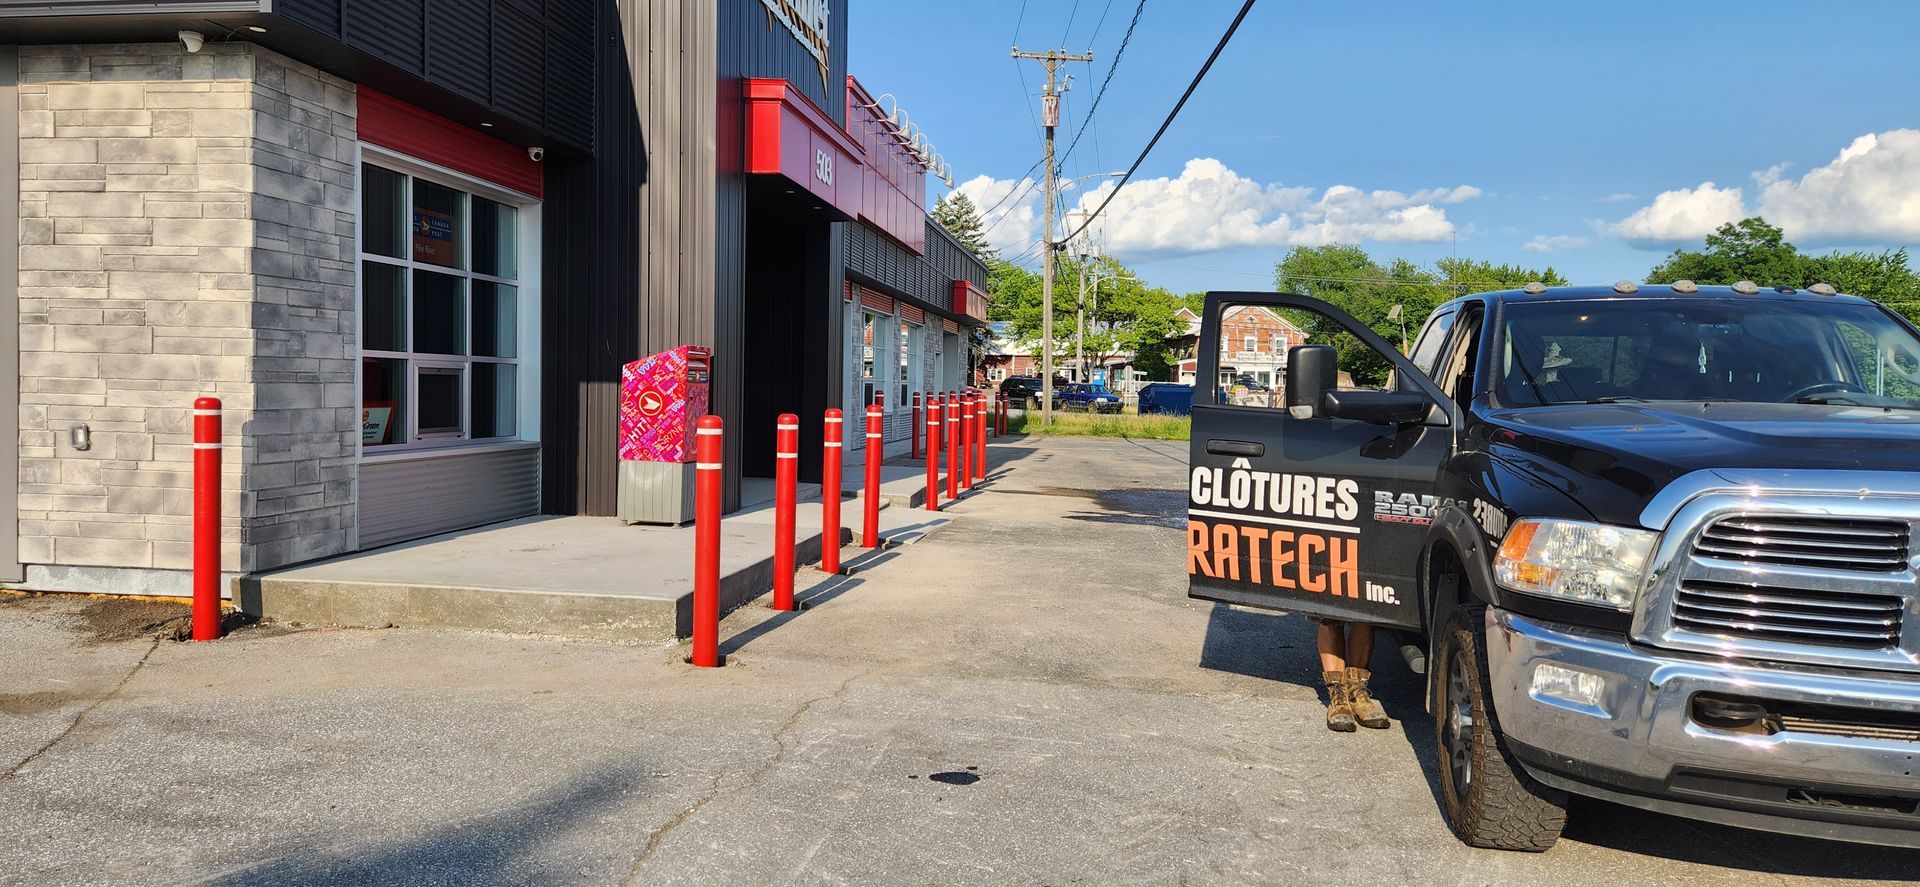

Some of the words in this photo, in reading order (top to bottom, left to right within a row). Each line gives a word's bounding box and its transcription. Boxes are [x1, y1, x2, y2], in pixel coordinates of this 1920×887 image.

[816, 149, 832, 186] 503
[431, 220, 450, 228] CANADA
[628, 421, 647, 442] H1T
[1191, 457, 1359, 521] CLÔTURES
[1374, 502, 1434, 518] 250
[1188, 519, 1359, 599] RATECH
[1366, 581, 1400, 605] inc.
